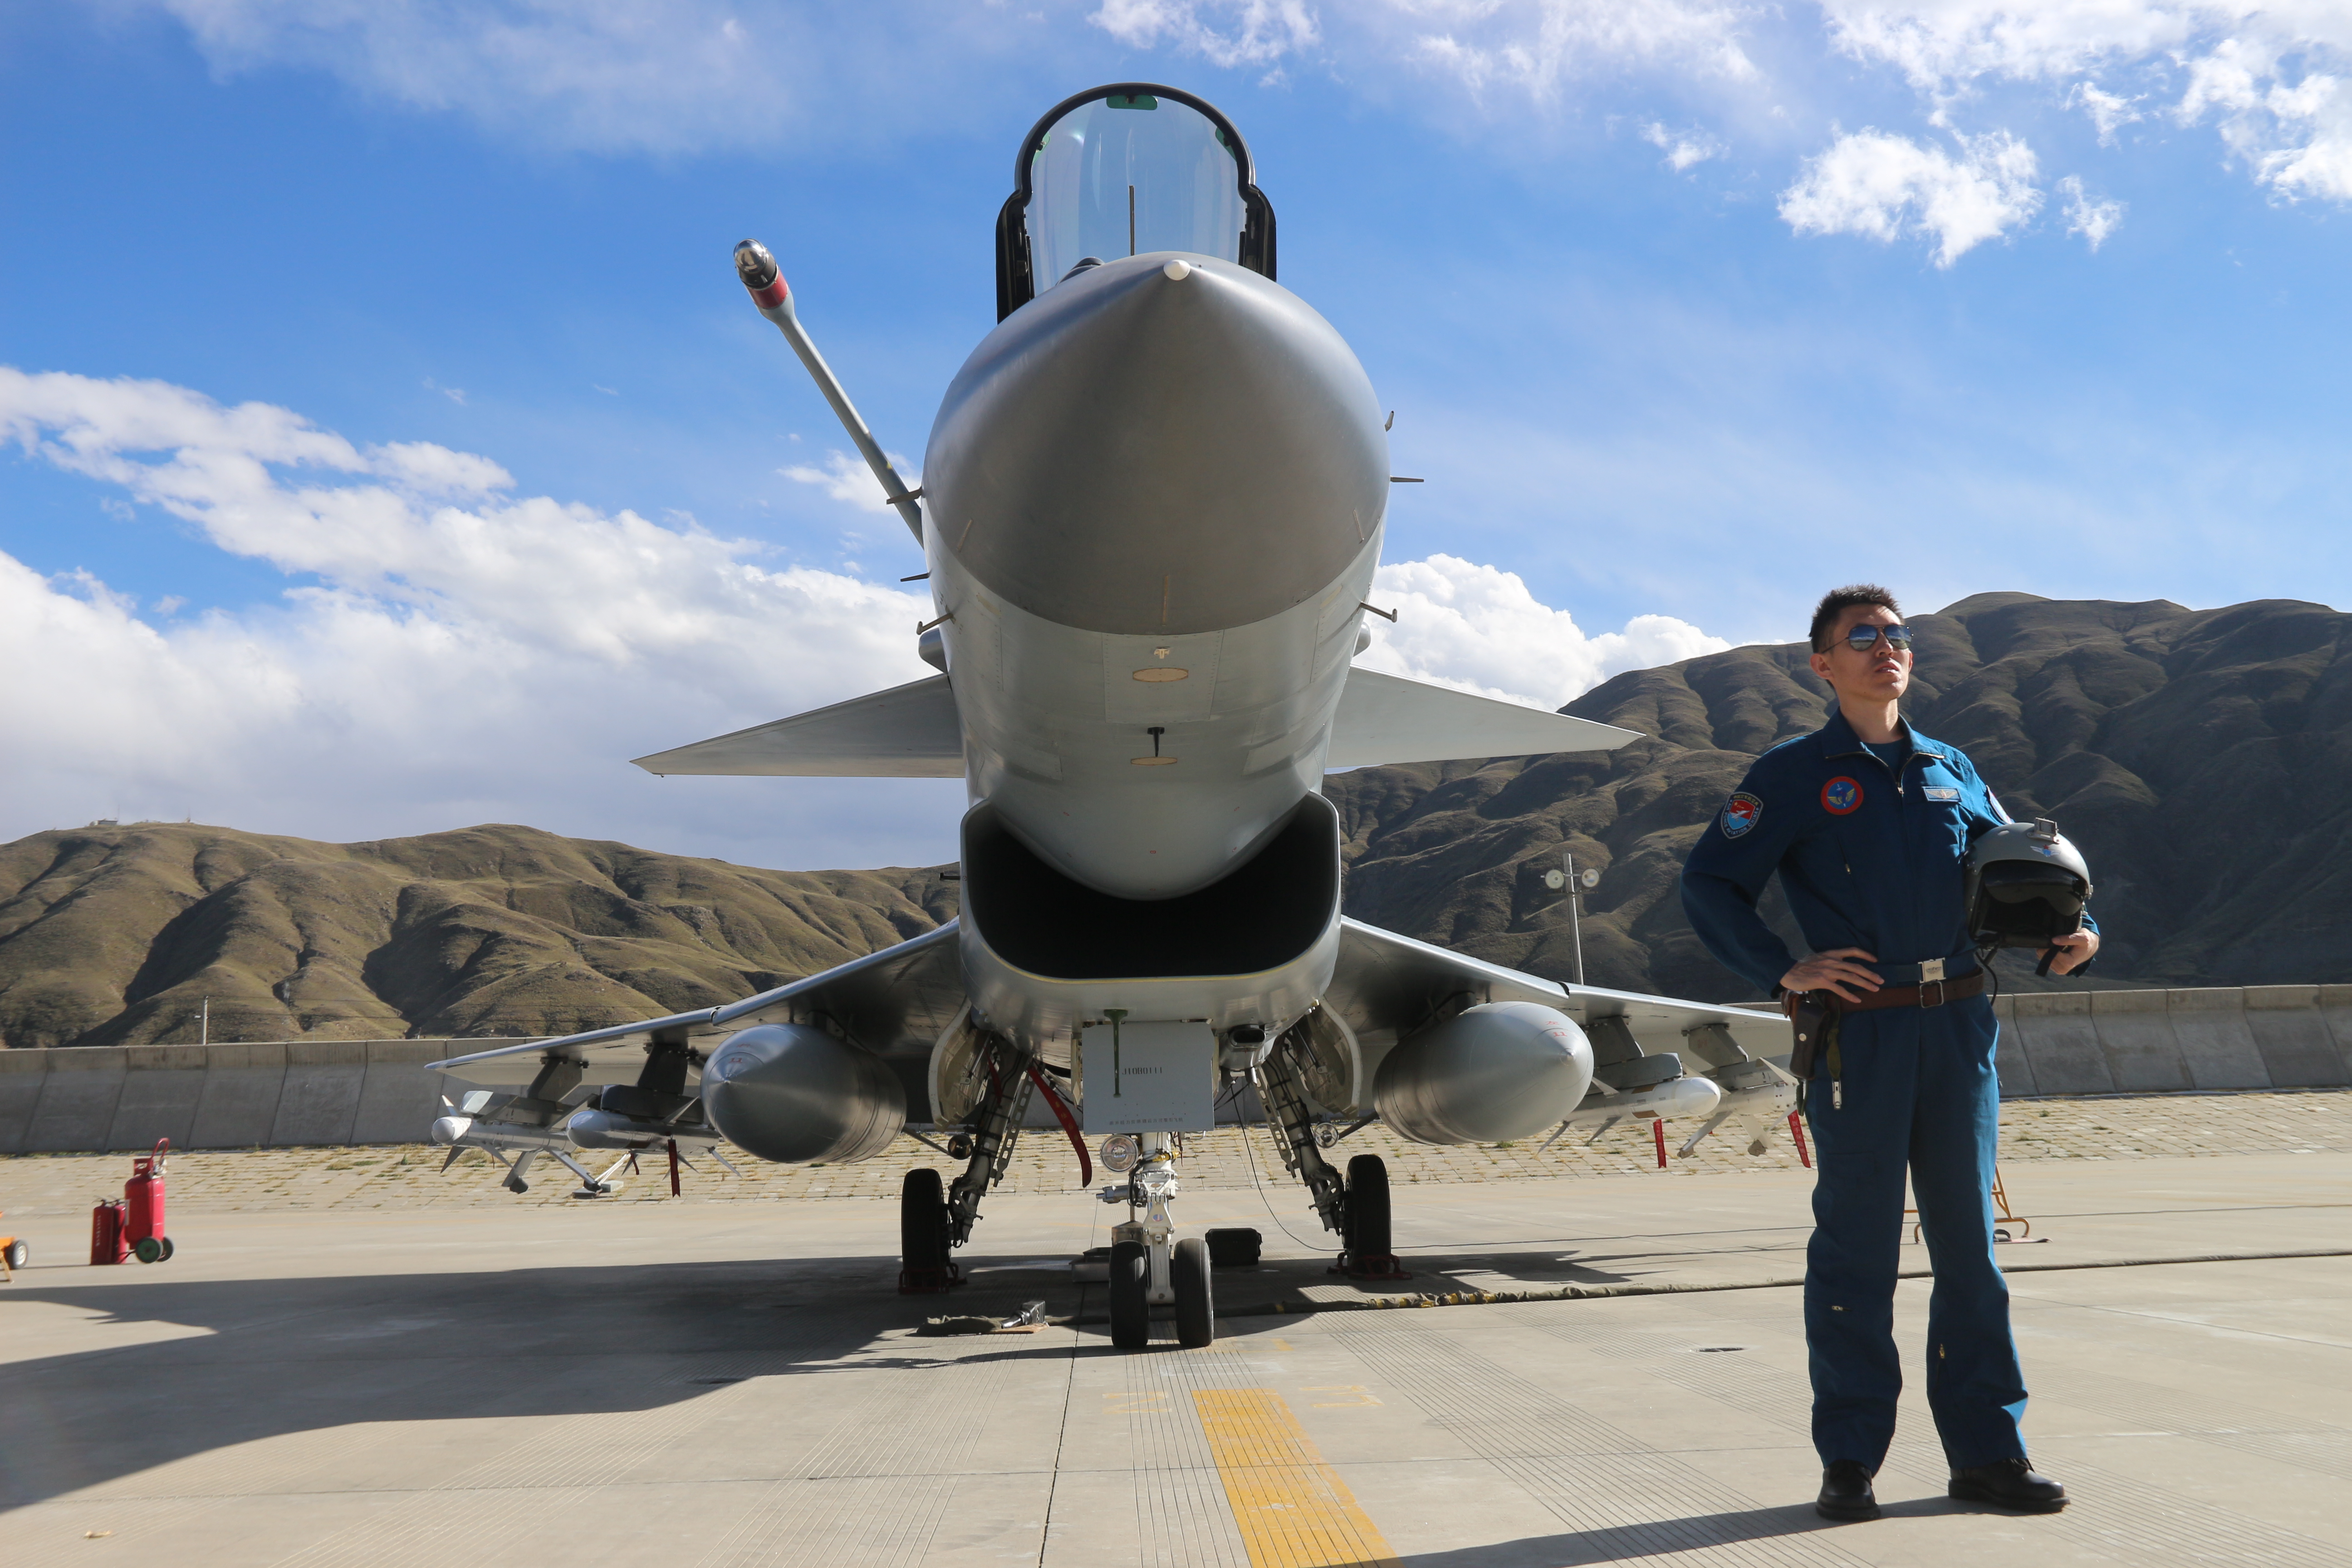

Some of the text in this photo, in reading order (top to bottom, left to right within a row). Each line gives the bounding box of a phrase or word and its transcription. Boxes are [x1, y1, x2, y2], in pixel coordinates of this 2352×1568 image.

[1726, 827, 1748, 835] AVIATION
[1748, 811, 1759, 827] CHINA
[1122, 1067, 1162, 1075] J10B0111
